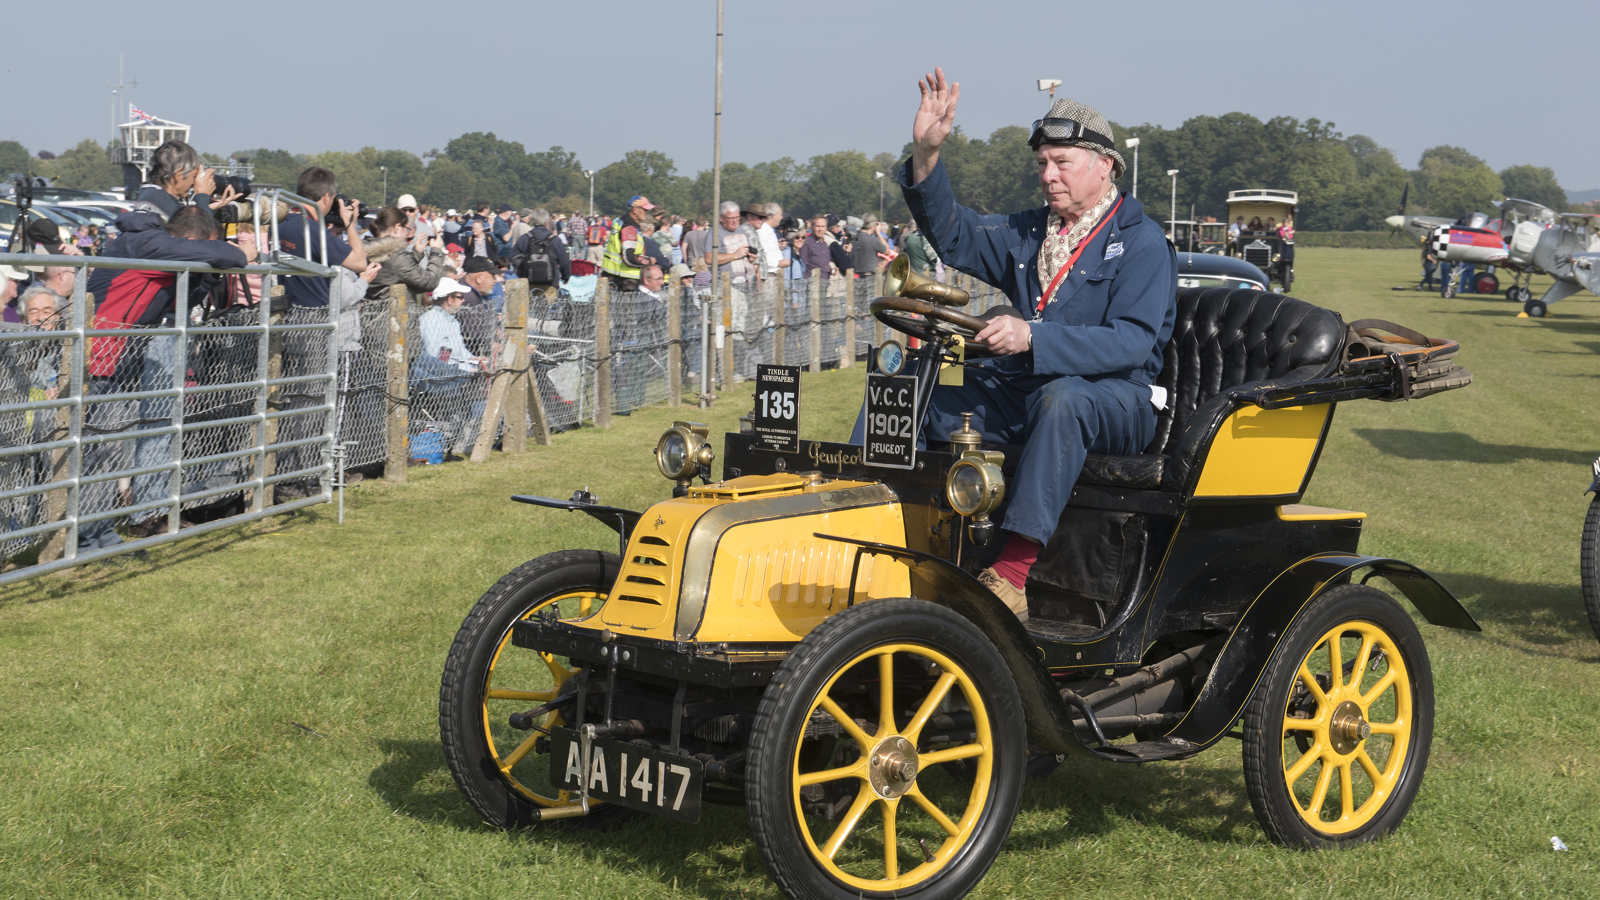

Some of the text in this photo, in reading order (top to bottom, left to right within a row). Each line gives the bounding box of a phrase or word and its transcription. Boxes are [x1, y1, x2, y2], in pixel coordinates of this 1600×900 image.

[761, 374, 795, 383] NEWSPAPERS
[767, 368, 790, 376] TINDLE
[759, 390, 795, 420] 135
[869, 386, 912, 408] V.C.C.
[868, 412, 912, 438] 1902
[870, 442, 906, 456] PEUGEOT
[564, 740, 691, 811] AA 1417
